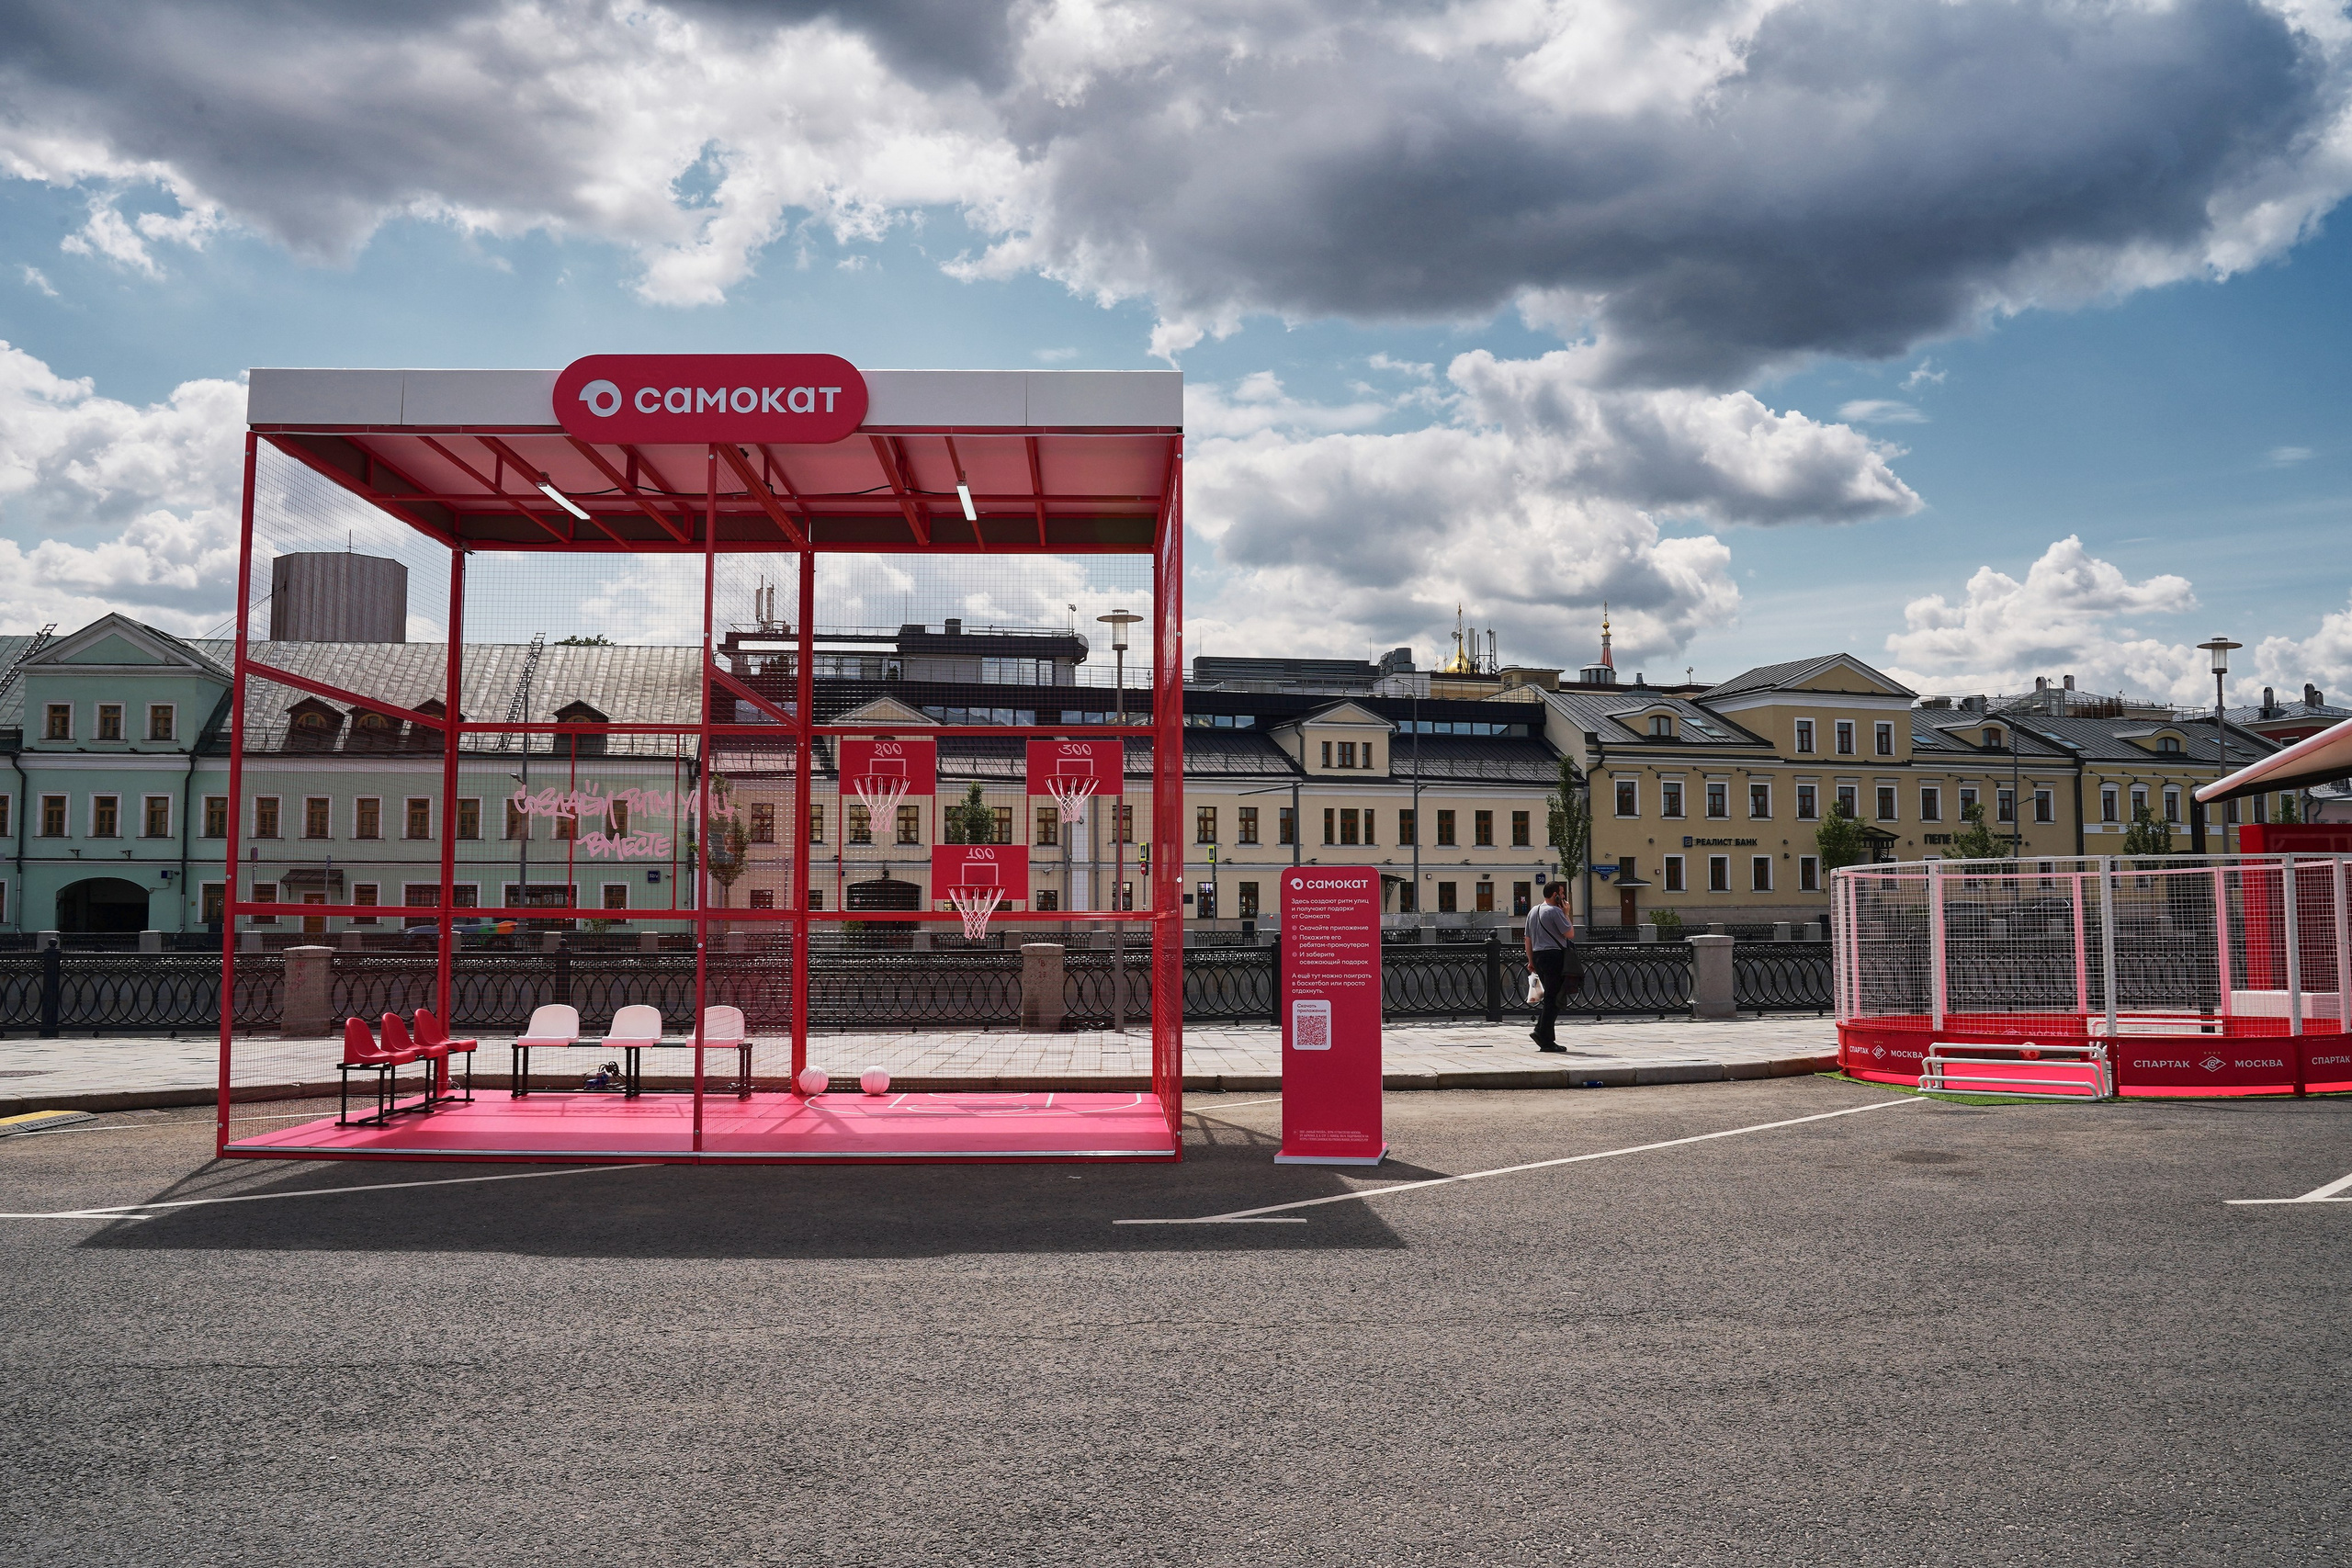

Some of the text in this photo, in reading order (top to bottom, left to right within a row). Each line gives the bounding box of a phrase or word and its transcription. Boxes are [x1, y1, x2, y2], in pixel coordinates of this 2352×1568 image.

[874, 742, 902, 758] 200
[1058, 743, 1092, 756] 300
[1695, 838, 1758, 846] РЕАЛИСТ БАНК
[1924, 833, 1952, 845] ПЕПЕ
[576, 830, 671, 862] ВМЕСТЕ
[966, 847, 995, 860] 100
[1849, 1045, 1870, 1055] СПАРТАК
[1890, 1049, 1924, 1060] МОСКВА
[2132, 1059, 2284, 1068] СПАРТАК МОСКВА
[2312, 1055, 2351, 1066] СПАРТАК
